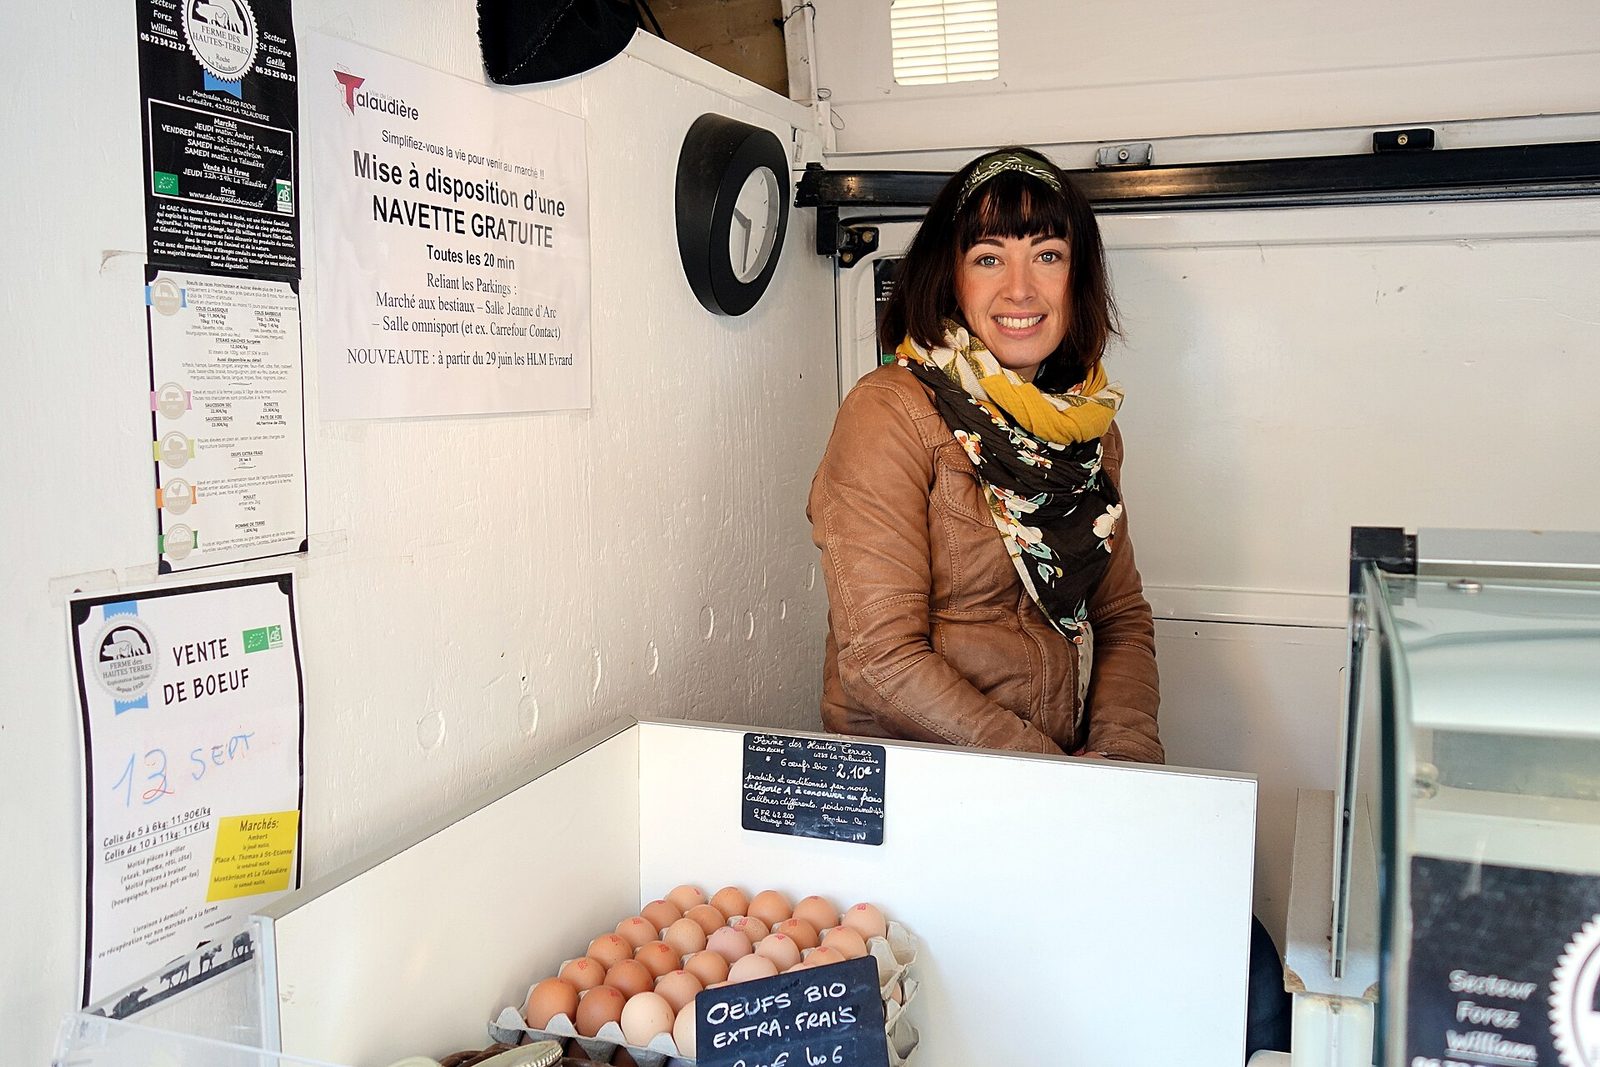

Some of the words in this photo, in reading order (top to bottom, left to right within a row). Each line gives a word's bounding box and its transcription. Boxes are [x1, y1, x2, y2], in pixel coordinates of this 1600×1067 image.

[153, 9, 172, 22] Forez
[151, 21, 178, 36] William
[201, 26, 227, 39] FERME
[228, 34, 241, 43] DES
[263, 32, 287, 44] Secteur
[141, 32, 149, 41] 06
[150, 35, 159, 44] 72
[160, 38, 168, 47] 34
[169, 41, 177, 49] 22
[178, 43, 186, 51] 27
[193, 32, 250, 55] HAUTES-TERRES
[269, 46, 291, 57] Etienne
[264, 68, 272, 76] 25
[272, 70, 280, 78] 25
[280, 72, 288, 80] 00
[223, 97, 240, 106] 42600
[241, 101, 257, 111] ROCHE
[214, 118, 237, 129] Marchés
[241, 109, 270, 121] TALAUDIERE
[162, 124, 195, 137] VENDREDI
[263, 146, 284, 156] Thomas
[195, 123, 214, 132] JEUDI
[235, 131, 255, 142] Ambert
[184, 147, 210, 158] SAMEDI
[187, 139, 213, 150] SAMEDI
[234, 148, 262, 159] Montbrison
[381, 129, 444, 156] Simplifiez-vous
[445, 146, 453, 158] la
[455, 149, 466, 161] vie
[468, 153, 485, 166] pour
[486, 158, 503, 169] venir
[503, 161, 512, 172] au
[515, 164, 538, 178] marché
[183, 168, 203, 177] JEUDI
[203, 163, 221, 172] Vente
[234, 169, 250, 177] ferme
[221, 187, 236, 195] Drive
[353, 150, 402, 185] Mise
[409, 162, 419, 189] à
[426, 167, 518, 209] disposition
[524, 189, 565, 217] d'une
[373, 194, 466, 236] NAVETTE
[471, 212, 553, 249] GRATUITE
[427, 244, 463, 264] Toutes
[466, 250, 481, 266] les
[484, 253, 495, 267] 20
[497, 256, 515, 270] min
[427, 273, 460, 290] Reliant
[462, 276, 474, 292] les
[477, 278, 511, 298] Parkings
[376, 292, 415, 309] Marché
[418, 298, 435, 310] aux
[439, 297, 475, 313] bestiaux
[485, 301, 504, 315] Salle
[507, 303, 534, 317] Jeanne
[536, 305, 557, 319] d'Arc
[382, 316, 409, 332] Salle
[411, 322, 459, 336] omnisport
[461, 322, 473, 337] (et
[475, 324, 488, 335] ex.
[490, 325, 527, 337] Carrefour
[529, 326, 561, 341] Contact)
[347, 348, 429, 365] NOUVEAUTE
[438, 350, 444, 365] à
[446, 352, 470, 368] partir
[473, 352, 484, 365] du
[486, 353, 496, 366] 29
[498, 354, 513, 368] juin
[515, 353, 525, 366] les
[527, 354, 547, 366] HLM
[549, 353, 573, 366] Evrard
[173, 638, 229, 666] VENTE
[103, 668, 128, 679] HAUTES
[130, 663, 152, 673] TERRES
[110, 660, 131, 670] FERME
[163, 681, 187, 705] DE
[194, 668, 249, 699] BOEUF
[753, 736, 784, 746] Ferme
[789, 739, 802, 749] des
[807, 741, 837, 752] Hautes
[842, 744, 872, 757] Terres
[813, 762, 828, 771] bio
[836, 763, 872, 780] 2,10€
[744, 772, 776, 782] produits
[778, 776, 785, 784] et
[787, 777, 828, 789] conditionnés
[830, 782, 845, 793] par
[744, 780, 782, 795] catégorie
[784, 786, 791, 795] A
[803, 789, 845, 800] conserver
[860, 792, 883, 806] frais
[746, 792, 779, 806] Calibres
[821, 801, 844, 812] poids
[103, 834, 123, 847] Colis
[126, 831, 135, 840] de
[138, 827, 143, 835] 5
[145, 825, 150, 833] à
[152, 821, 169, 831] 6kg:
[171, 807, 211, 825] 11,90€/kg
[240, 817, 279, 832] Marchés:
[105, 848, 124, 861] Colis
[127, 845, 137, 854] de
[140, 839, 150, 849] 10
[152, 837, 157, 845] à
[160, 831, 180, 842] 11kg:
[184, 821, 210, 835] 11€/kg
[127, 857, 146, 869] Moitié
[147, 854, 164, 865] pièces
[170, 845, 186, 856] griller
[265, 849, 293, 858] St-Etienne
[214, 873, 246, 883] Montbrison
[133, 920, 158, 934] Livraison
[164, 918, 186, 933] marchés
[1449, 969, 1537, 1000] Secteur
[707, 993, 791, 1025] OEUFS
[804, 983, 846, 1002] BIO
[1456, 1000, 1521, 1029] Forez
[1445, 1029, 1538, 1061] William
[832, 1046, 842, 1064] 6
